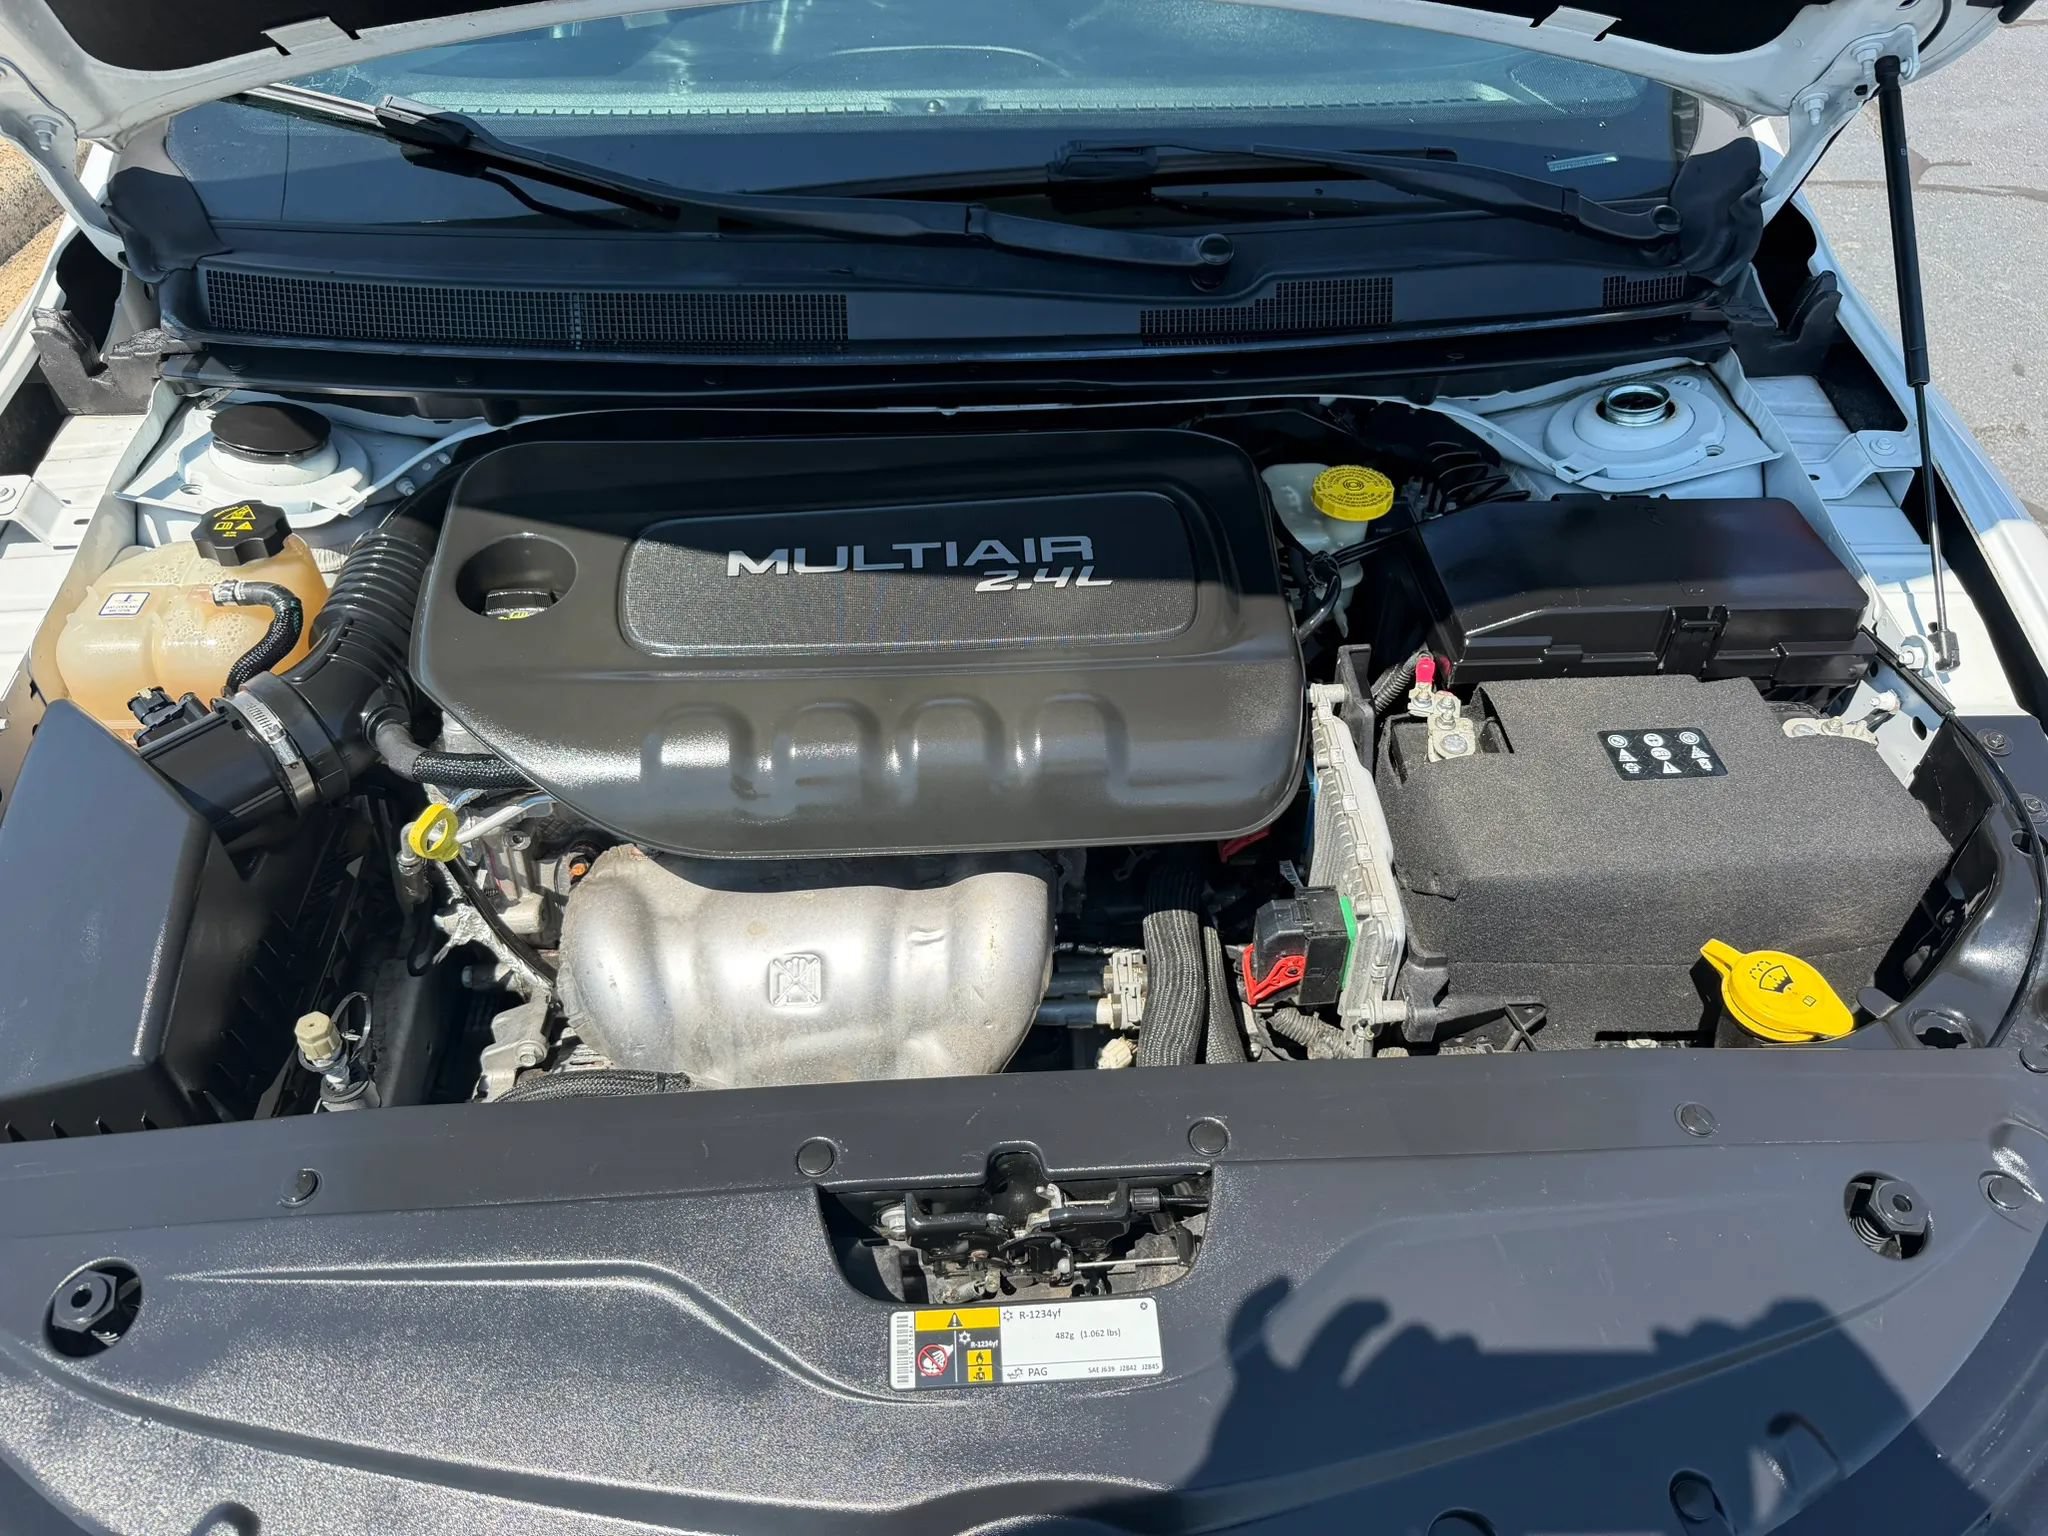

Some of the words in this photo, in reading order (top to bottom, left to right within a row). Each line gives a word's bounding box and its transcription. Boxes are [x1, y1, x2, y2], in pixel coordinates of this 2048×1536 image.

[727, 535, 1095, 577] MULTIAIR
[975, 565, 1114, 593] 2.4L
[1019, 1308, 1061, 1321] R-1234yf
[1027, 1366, 1048, 1377] PAG
